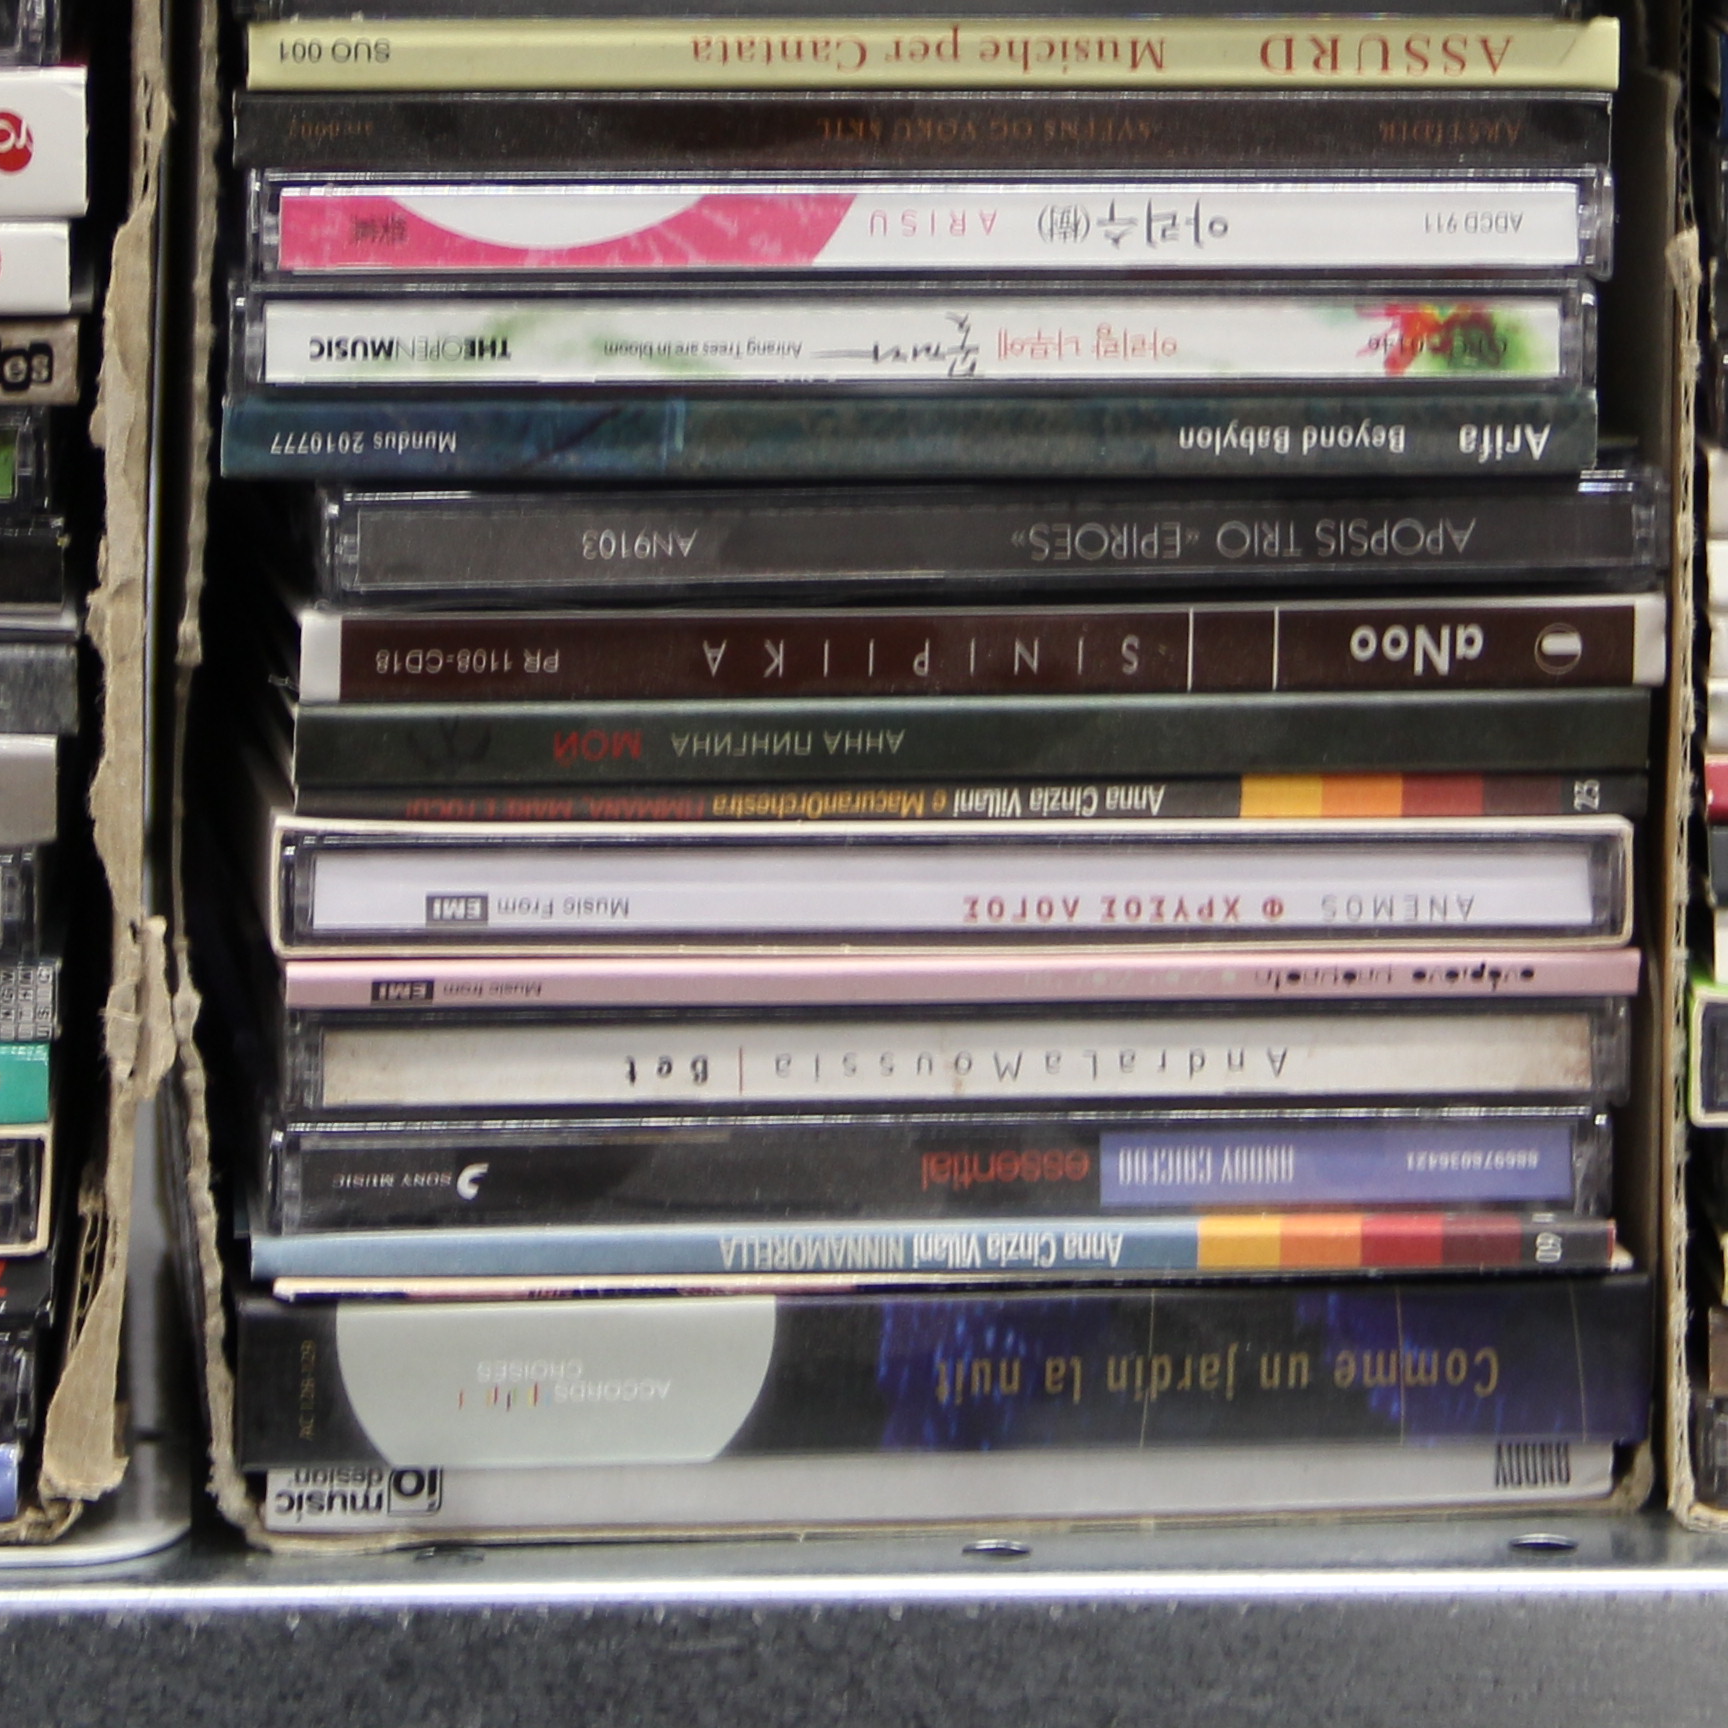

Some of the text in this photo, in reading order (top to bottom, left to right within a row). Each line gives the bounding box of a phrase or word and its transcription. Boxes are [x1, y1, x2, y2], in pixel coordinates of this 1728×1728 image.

[690, 25, 1513, 76] ASSURD Musiche per Cantata
[270, 430, 456, 454] Mundus 2010777
[1178, 419, 1550, 460] Arifa Beyond Babylon
[1350, 624, 1483, 674] aNoo
[554, 729, 904, 766] АННА ПИНГИНА МОЙ
[953, 784, 1165, 818] Anna Cinzia Villani
[933, 1344, 1499, 1402] Comme un jardin la nuit
